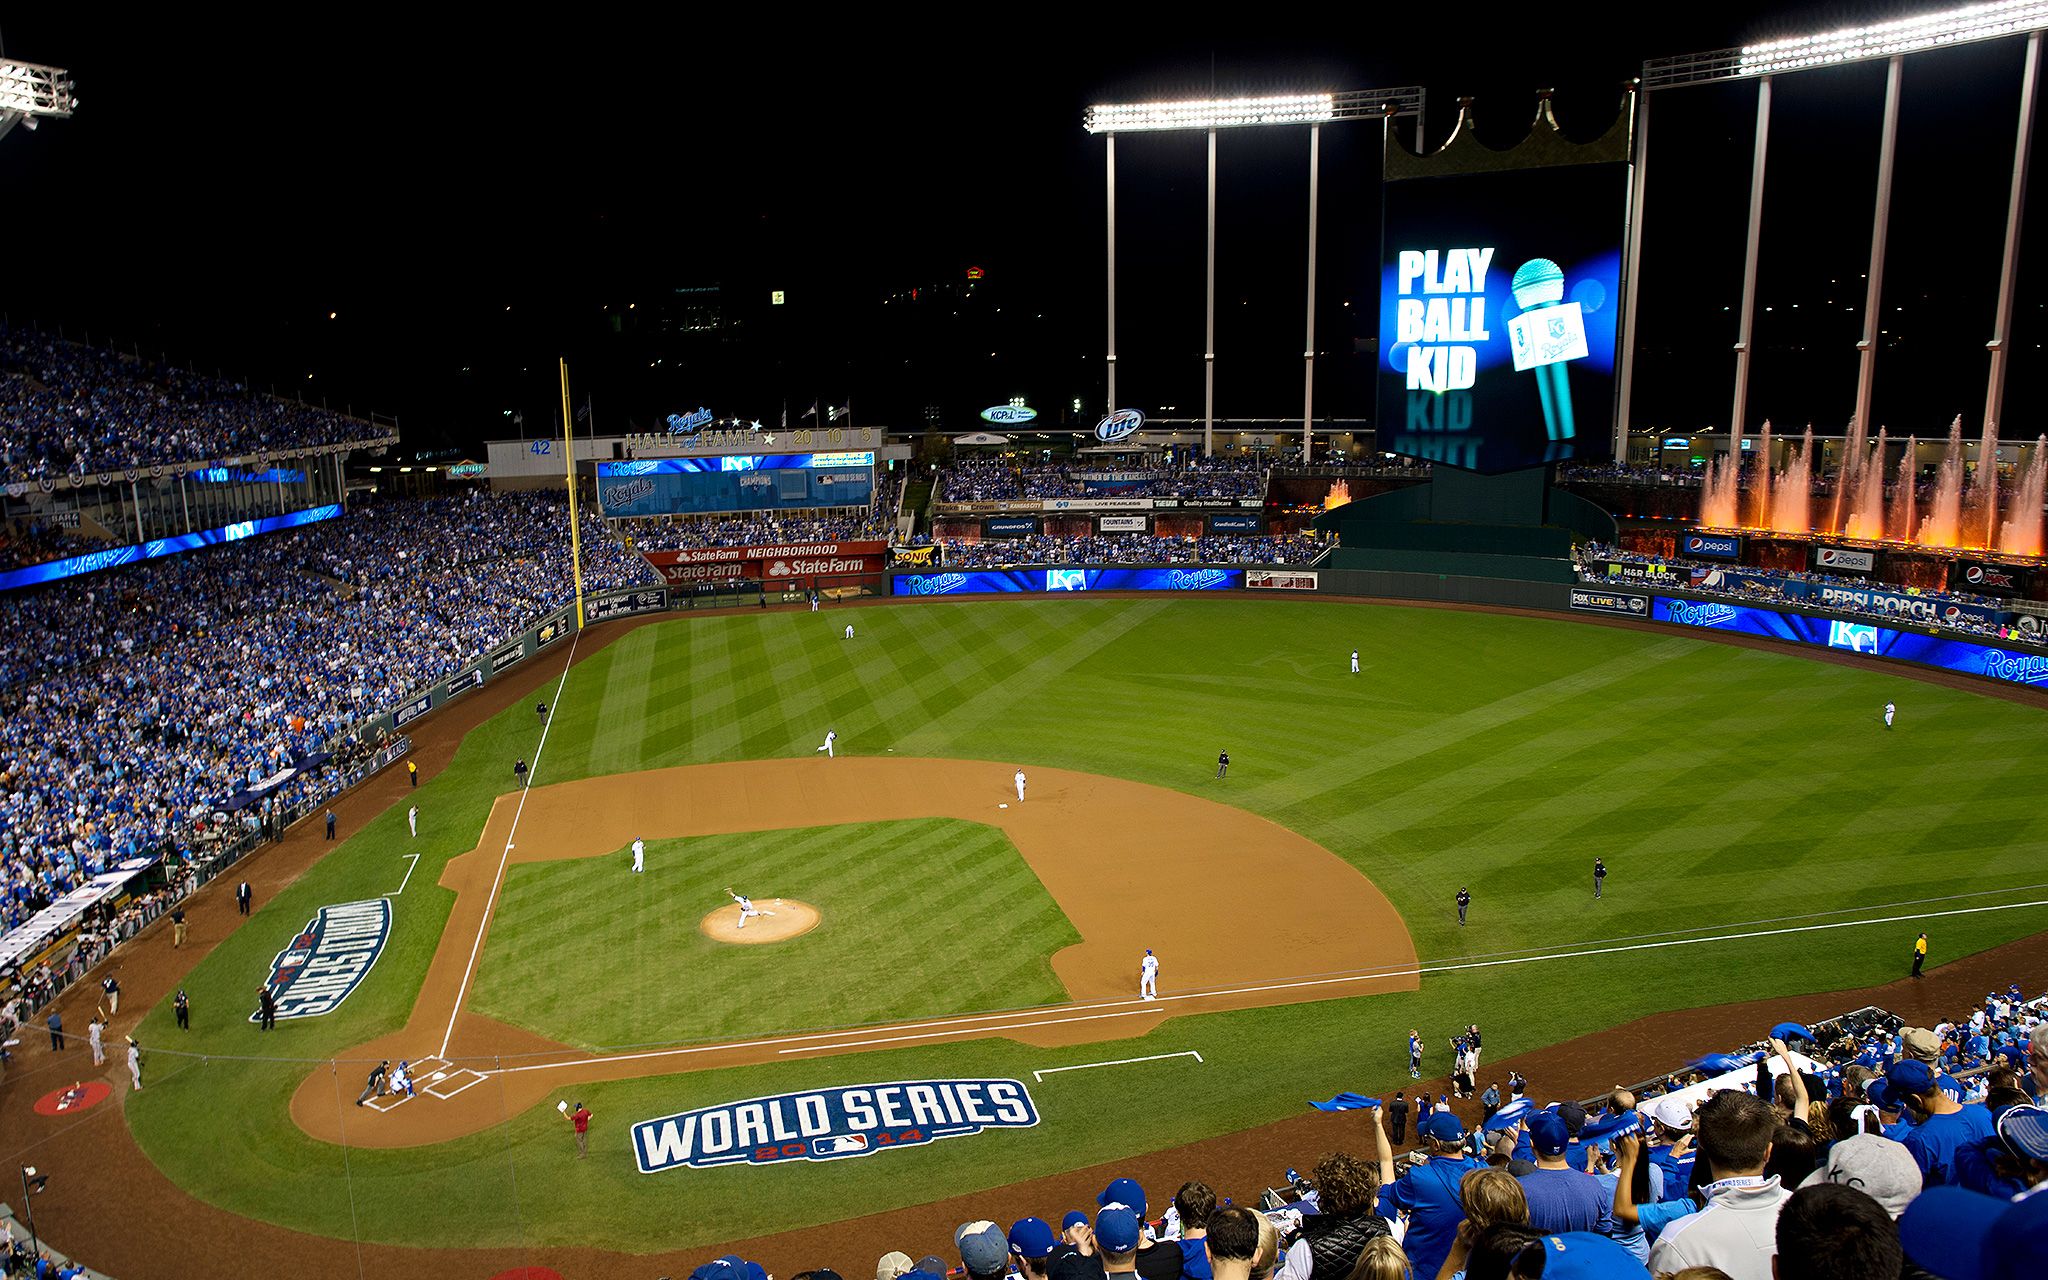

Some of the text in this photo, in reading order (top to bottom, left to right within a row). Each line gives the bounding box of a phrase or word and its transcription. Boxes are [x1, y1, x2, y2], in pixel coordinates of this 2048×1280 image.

[1398, 248, 1495, 294] PLAY
[1397, 297, 1489, 342] BALL
[1406, 346, 1477, 390] KID
[667, 406, 713, 435] Royals
[1105, 417, 1138, 439] Lite
[530, 440, 551, 455] 42
[626, 429, 756, 451] HALL of FAME
[792, 427, 872, 445] 20 10 5
[604, 478, 656, 509] Royals
[747, 545, 837, 558] NEIGHBORHOOD
[896, 550, 932, 562] SONIC
[1704, 541, 1732, 552] pepsi
[1837, 555, 1867, 567] pepsi
[1623, 568, 1678, 580] H&R BLOCK
[1573, 594, 1588, 602] FOX
[1591, 597, 1614, 605] LIVE
[1823, 588, 1936, 618] PEPSI PORCH
[1666, 599, 1737, 627] Royals
[1981, 648, 2048, 684] Royal
[316, 900, 384, 954] WORLD
[270, 951, 372, 1017] SERIES
[641, 1081, 1030, 1167] WORLD SERIES
[755, 1129, 923, 1160] 20 14
[1737, 1178, 1752, 1187] SERIES
